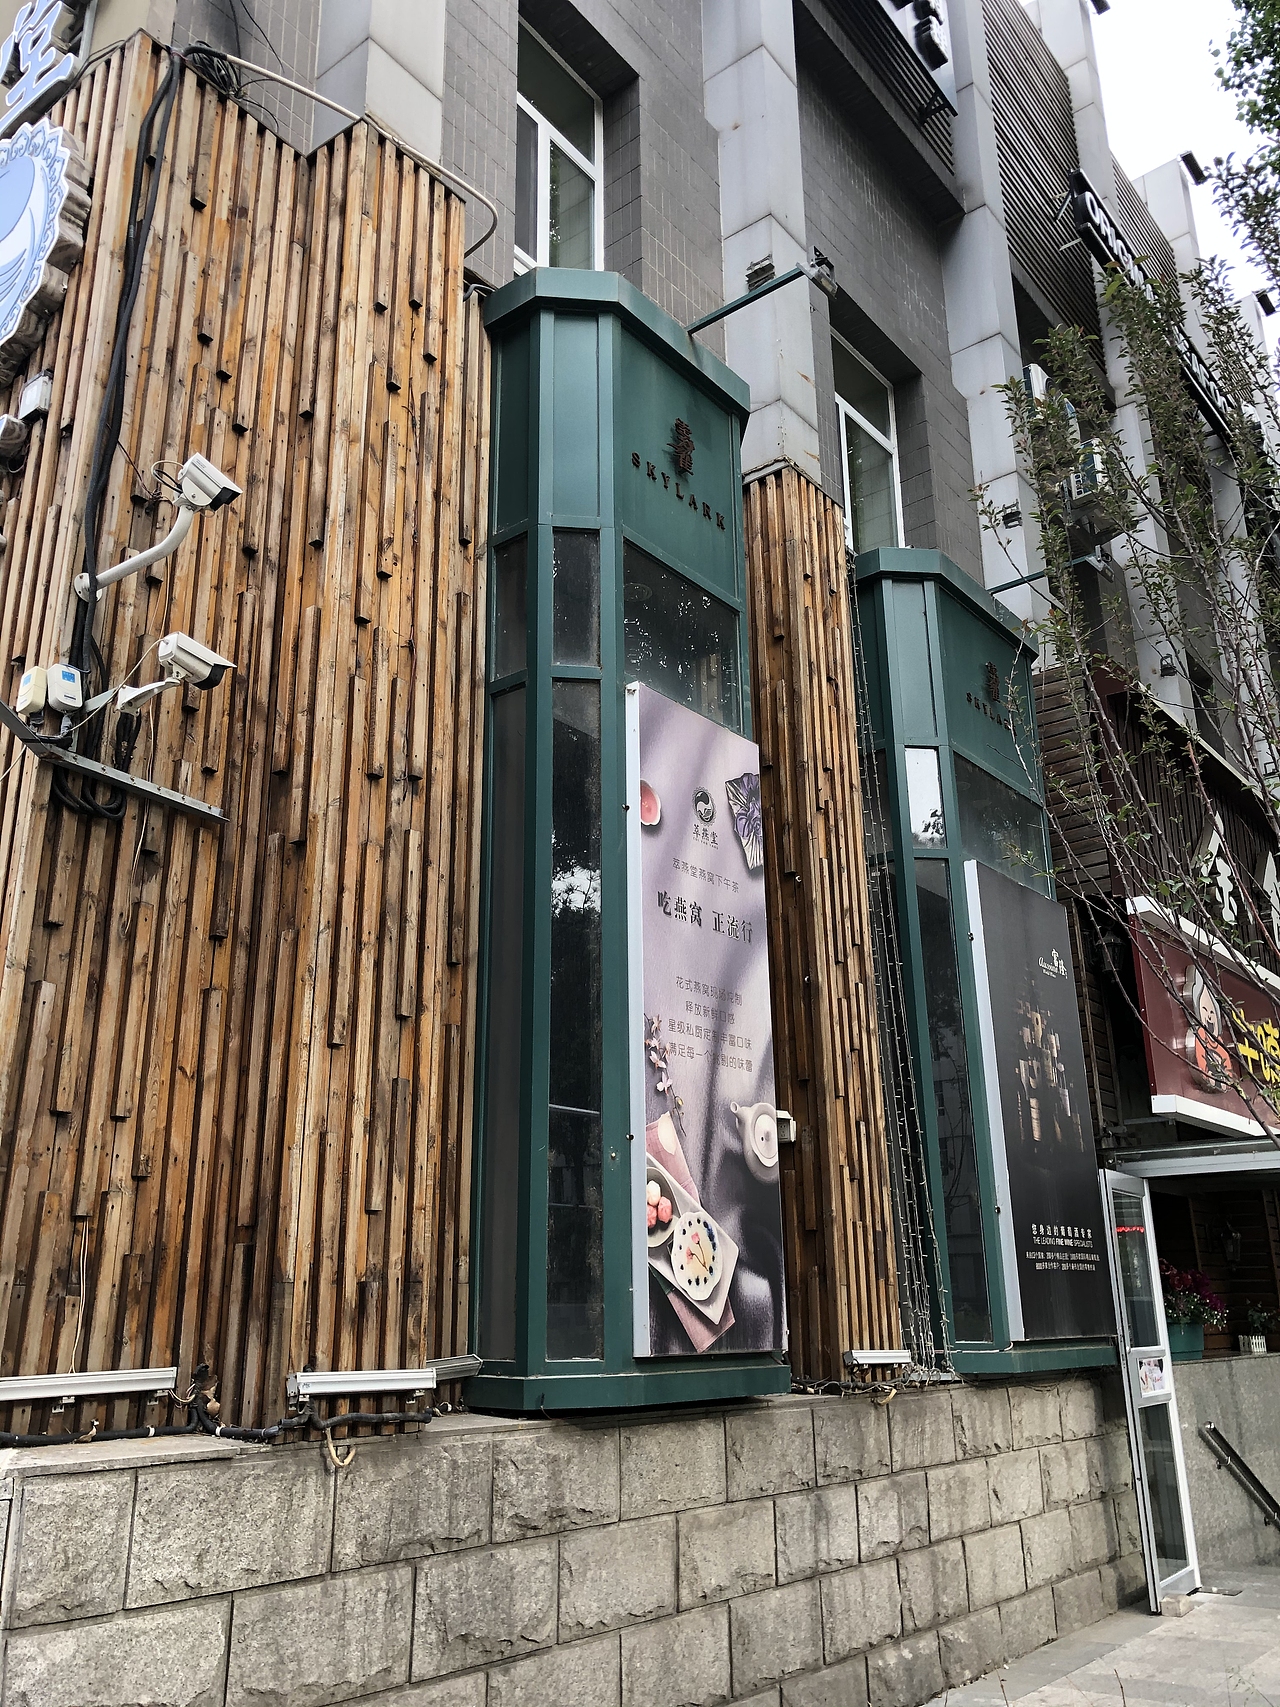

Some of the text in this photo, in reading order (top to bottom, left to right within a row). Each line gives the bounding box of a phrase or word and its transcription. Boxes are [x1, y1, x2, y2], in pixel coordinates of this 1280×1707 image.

[631, 452, 726, 531] SKYLARK
[657, 890, 753, 943] 吃燕窝 正流行
